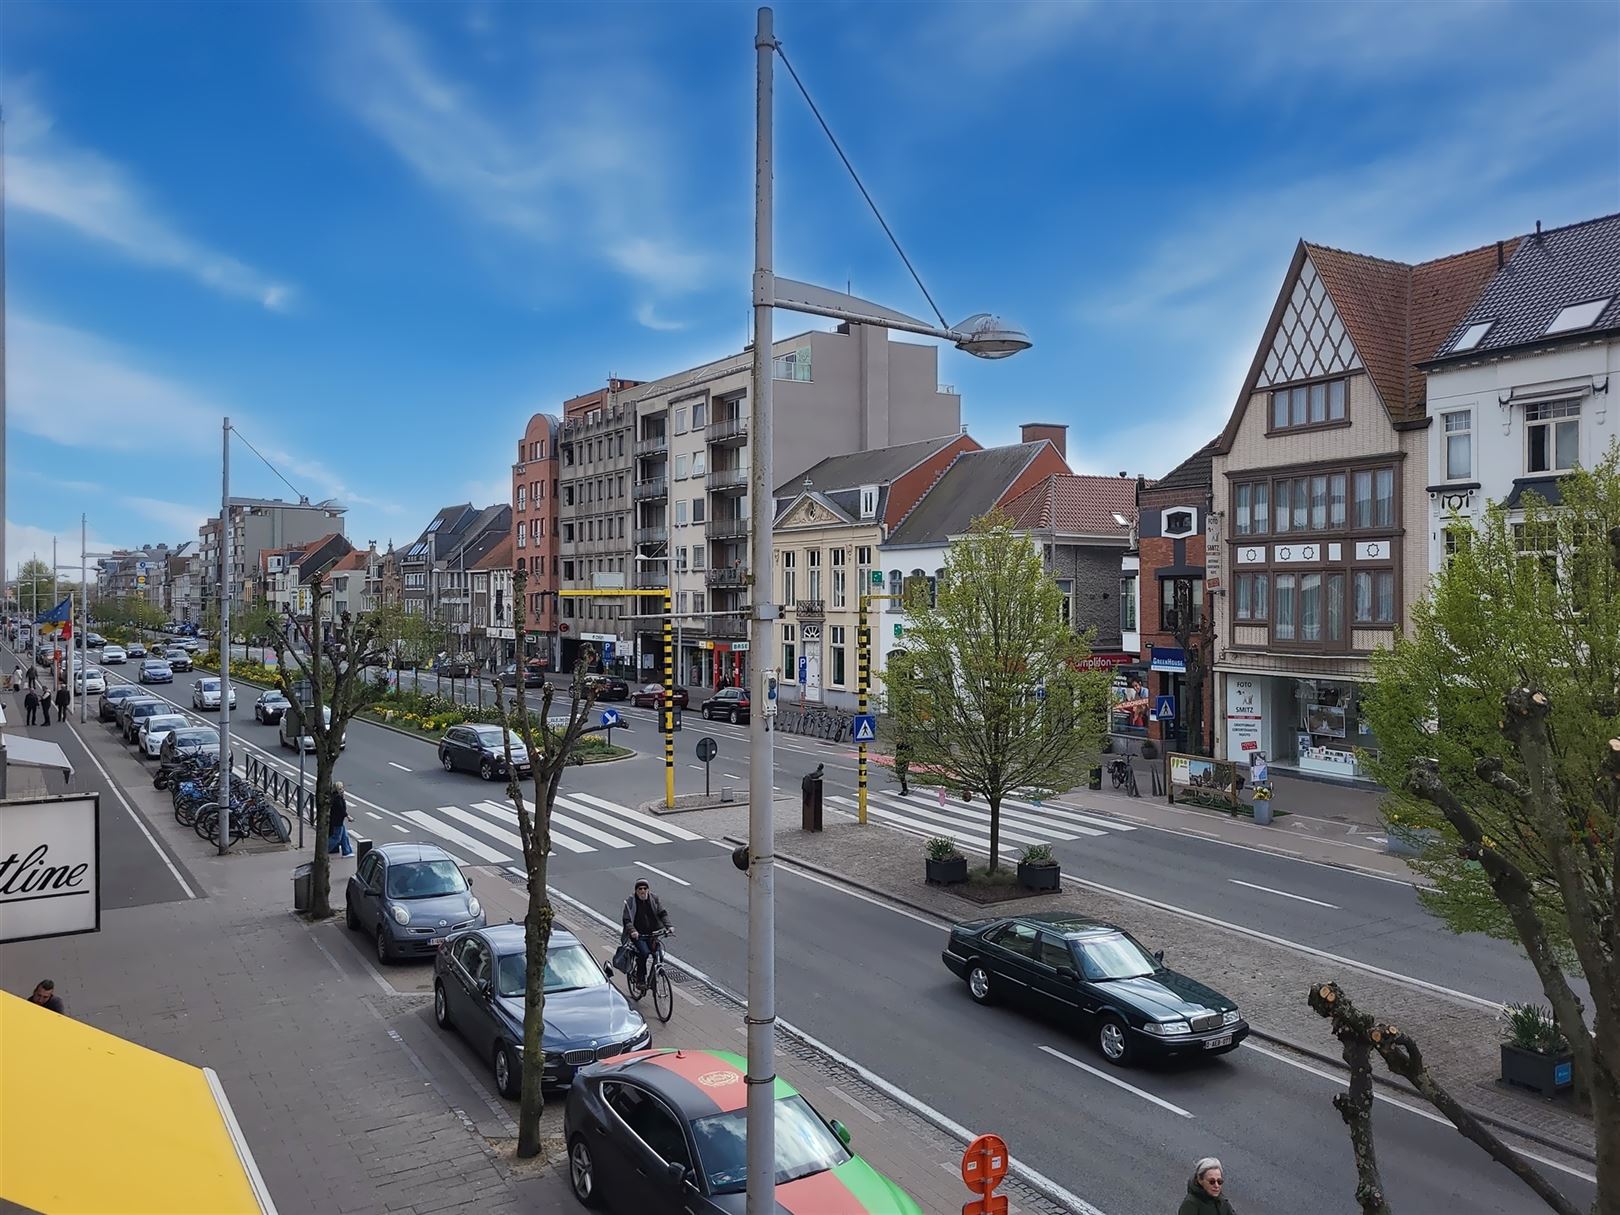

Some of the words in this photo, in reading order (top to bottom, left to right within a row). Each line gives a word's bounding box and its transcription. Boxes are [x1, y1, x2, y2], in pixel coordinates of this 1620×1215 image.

[800, 658, 806, 668] P
[1235, 706, 1254, 714] SMITZ
[0, 844, 89, 895] tline
